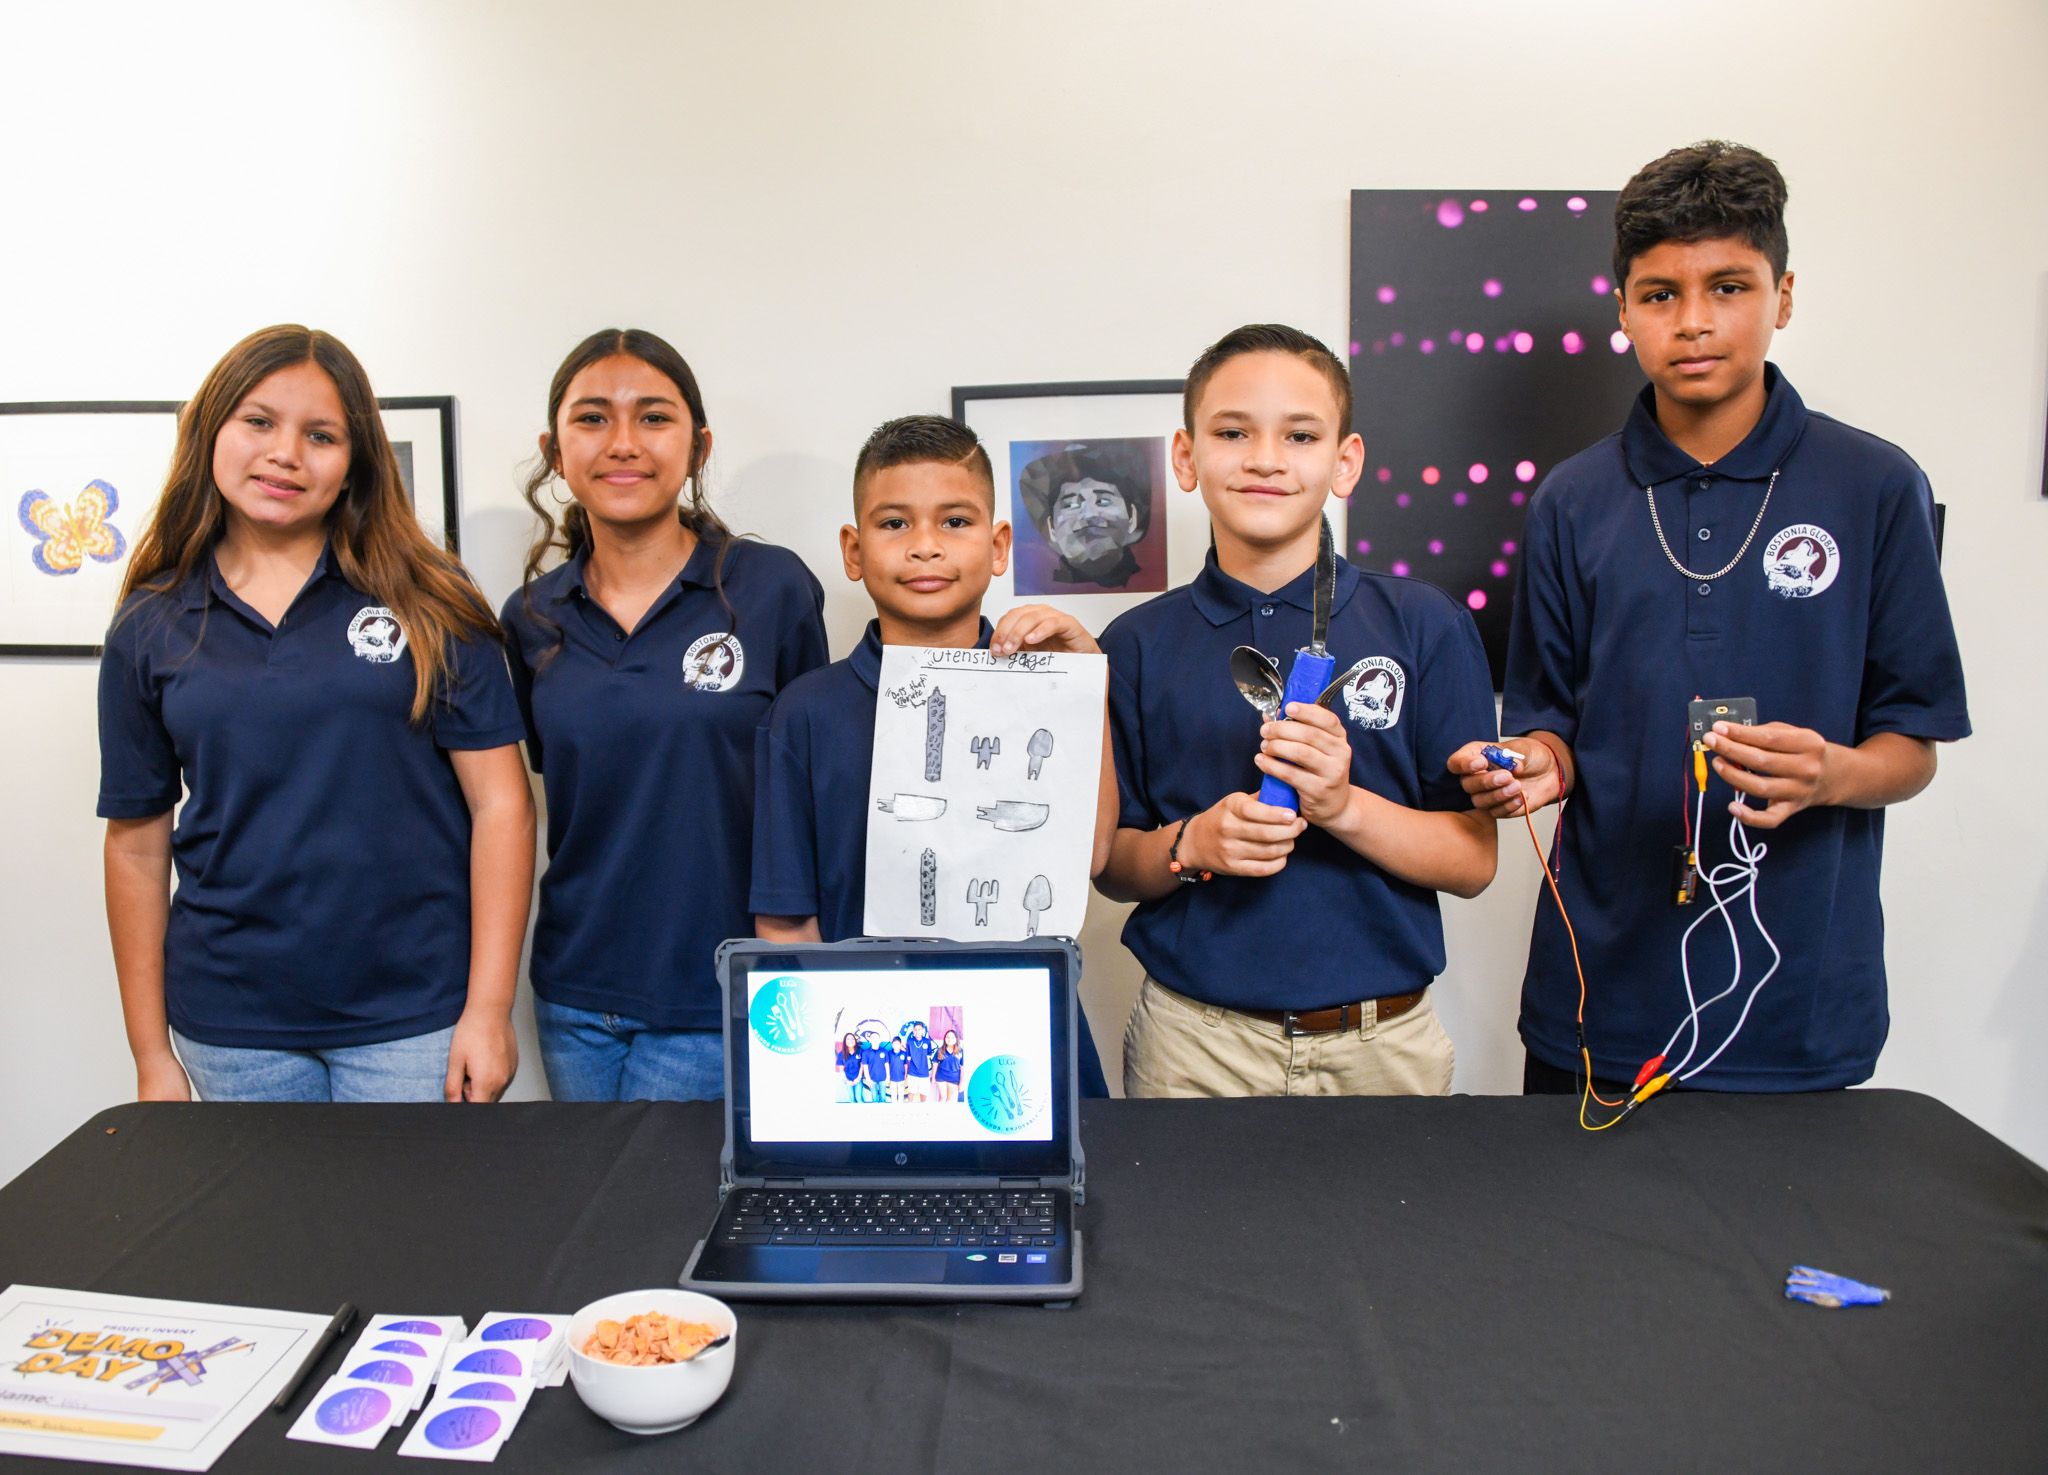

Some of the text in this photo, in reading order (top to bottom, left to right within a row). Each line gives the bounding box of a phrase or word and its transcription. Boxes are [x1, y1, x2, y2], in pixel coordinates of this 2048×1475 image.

[1766, 526, 1837, 558] BOSTONIA GLOBAL
[349, 609, 380, 632] BOSTONIA
[727, 637, 742, 662] LOBAL
[1346, 658, 1404, 691] BTONIA GLOBAL
[23, 1328, 185, 1361] DEMO
[13, 1352, 143, 1382] DAY
[0, 1389, 53, 1404] ame:
